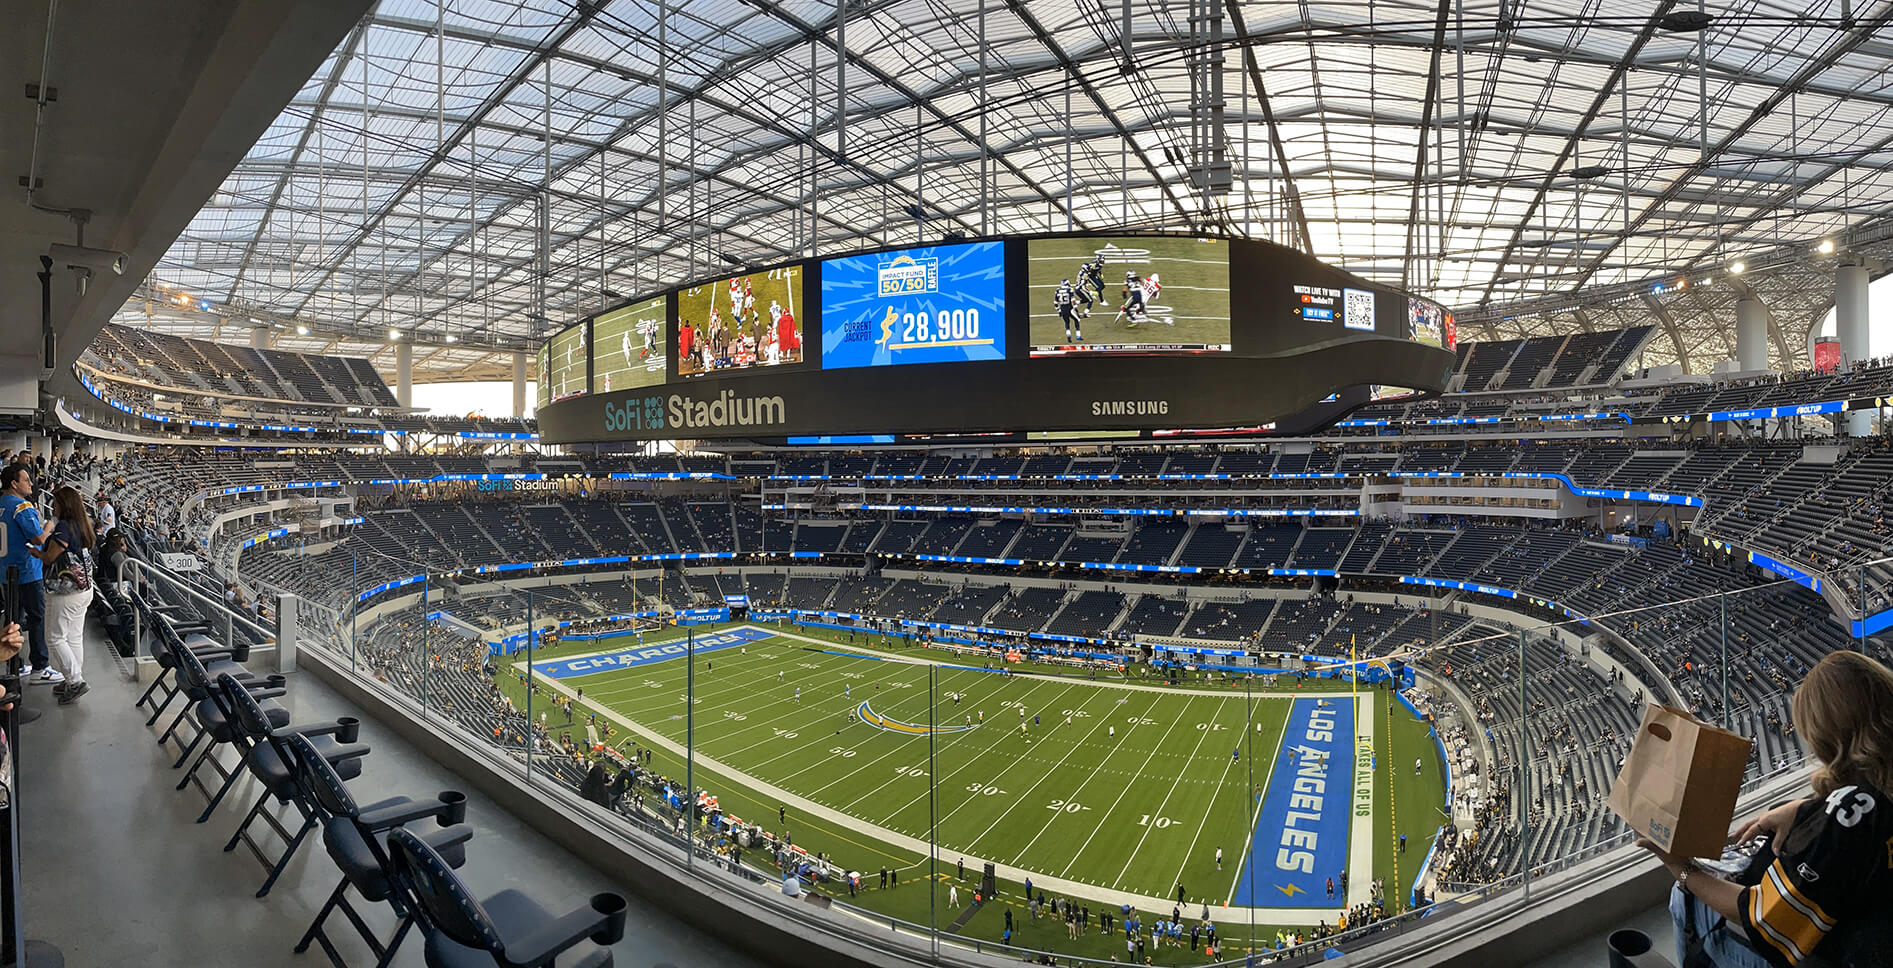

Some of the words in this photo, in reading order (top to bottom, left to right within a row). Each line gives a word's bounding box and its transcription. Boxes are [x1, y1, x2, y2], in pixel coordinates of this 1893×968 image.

[882, 271, 905, 280] IMPACT
[906, 270, 924, 278] FUND
[927, 261, 937, 289] RAFFLE
[882, 277, 924, 293] 50/50
[844, 320, 872, 333] CURRENT
[844, 331, 872, 343] JACKPOT
[605, 398, 641, 431] SoFi
[668, 389, 785, 429] Stadium
[1092, 400, 1169, 416] SAMSUNG
[478, 479, 501, 491] SoFi
[514, 479, 558, 490] Stadium
[176, 558, 193, 568] 300
[567, 634, 736, 671] CHARGERS
[1305, 709, 1337, 743] LOS
[774, 729, 799, 739] 40
[829, 746, 857, 758] 50
[894, 765, 924, 777] 40
[1357, 771, 1371, 786] ALL
[965, 782, 998, 796] 30
[1356, 788, 1371, 800] OF
[1046, 799, 1081, 813] 20
[1275, 744, 1331, 874] ANGELES
[1355, 803, 1370, 817] US
[1824, 785, 1876, 828] 43
[1137, 814, 1171, 829] 10
